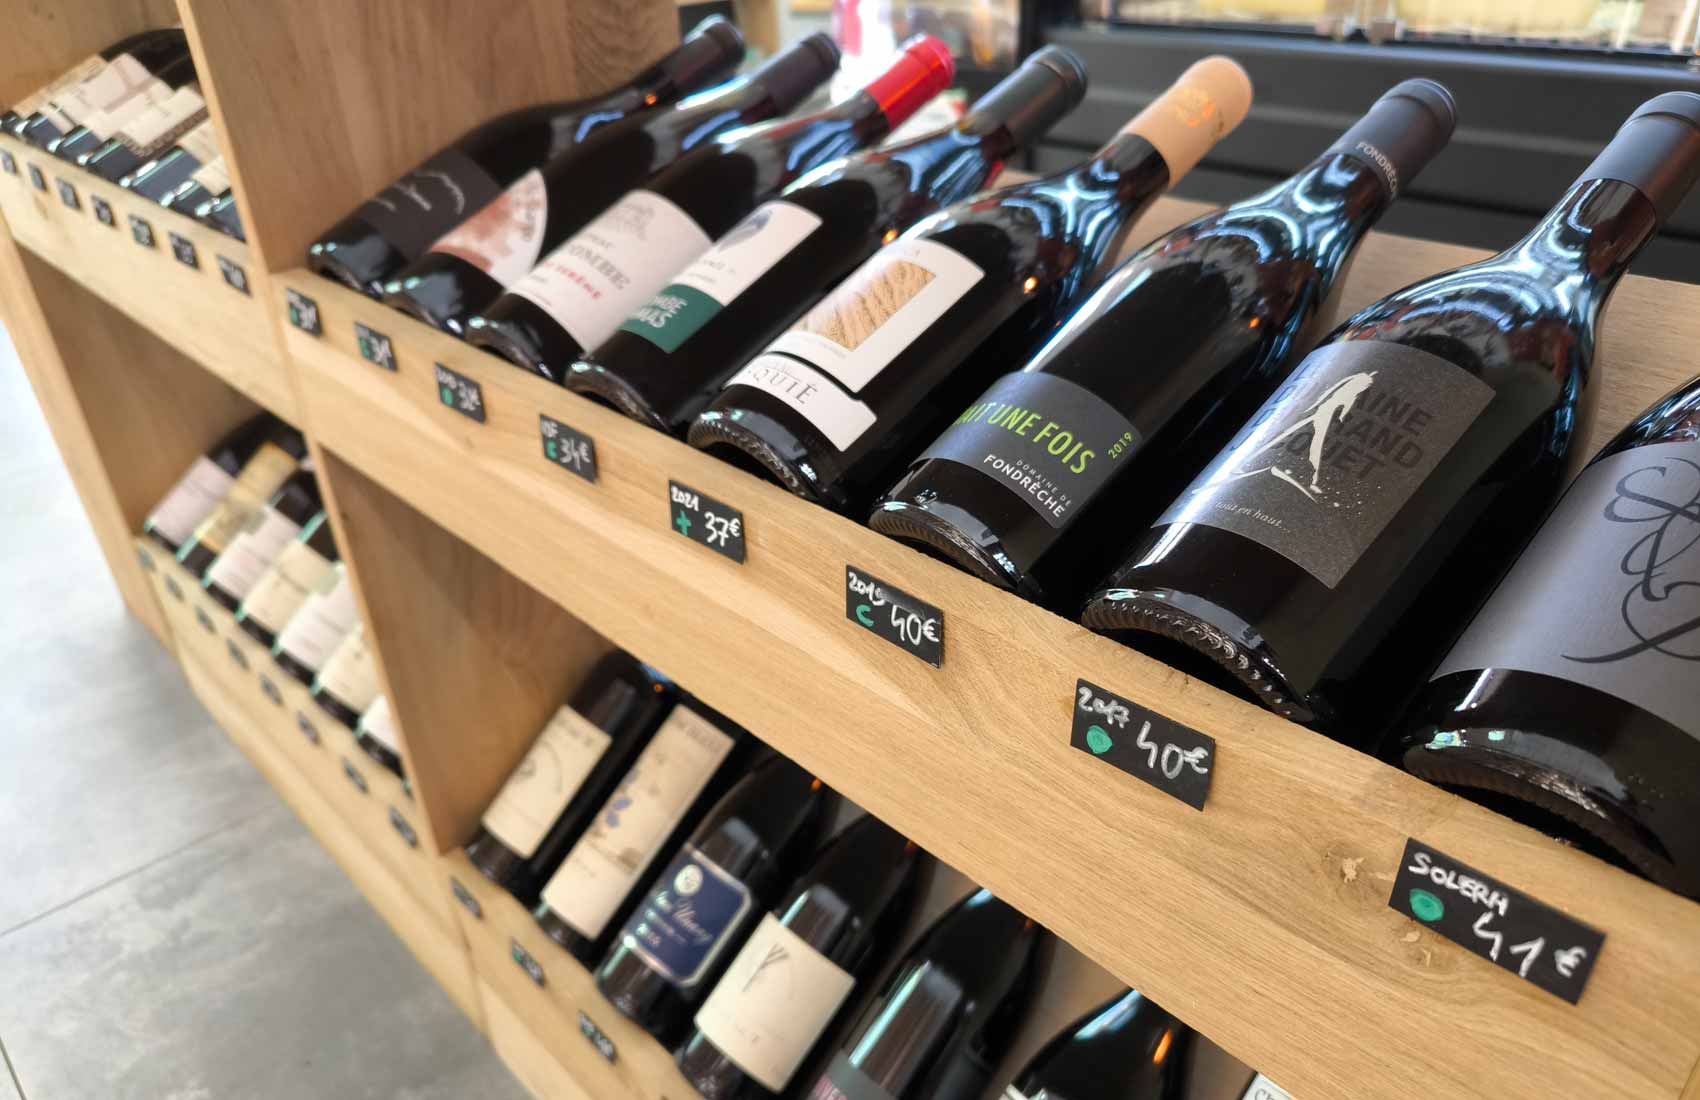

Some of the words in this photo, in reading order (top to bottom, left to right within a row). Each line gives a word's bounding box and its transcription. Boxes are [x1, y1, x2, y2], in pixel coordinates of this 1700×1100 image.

[987, 403, 1041, 437] UNE
[1032, 421, 1096, 474] FOIS
[1107, 431, 1134, 460] 2019
[671, 485, 699, 512] 2021
[1016, 458, 1058, 495] DOMAINE
[1058, 493, 1073, 508] DE
[704, 511, 741, 547] 37€
[890, 604, 940, 646] 40€
[1078, 686, 1130, 729] 2017
[1136, 720, 1209, 780] 40€
